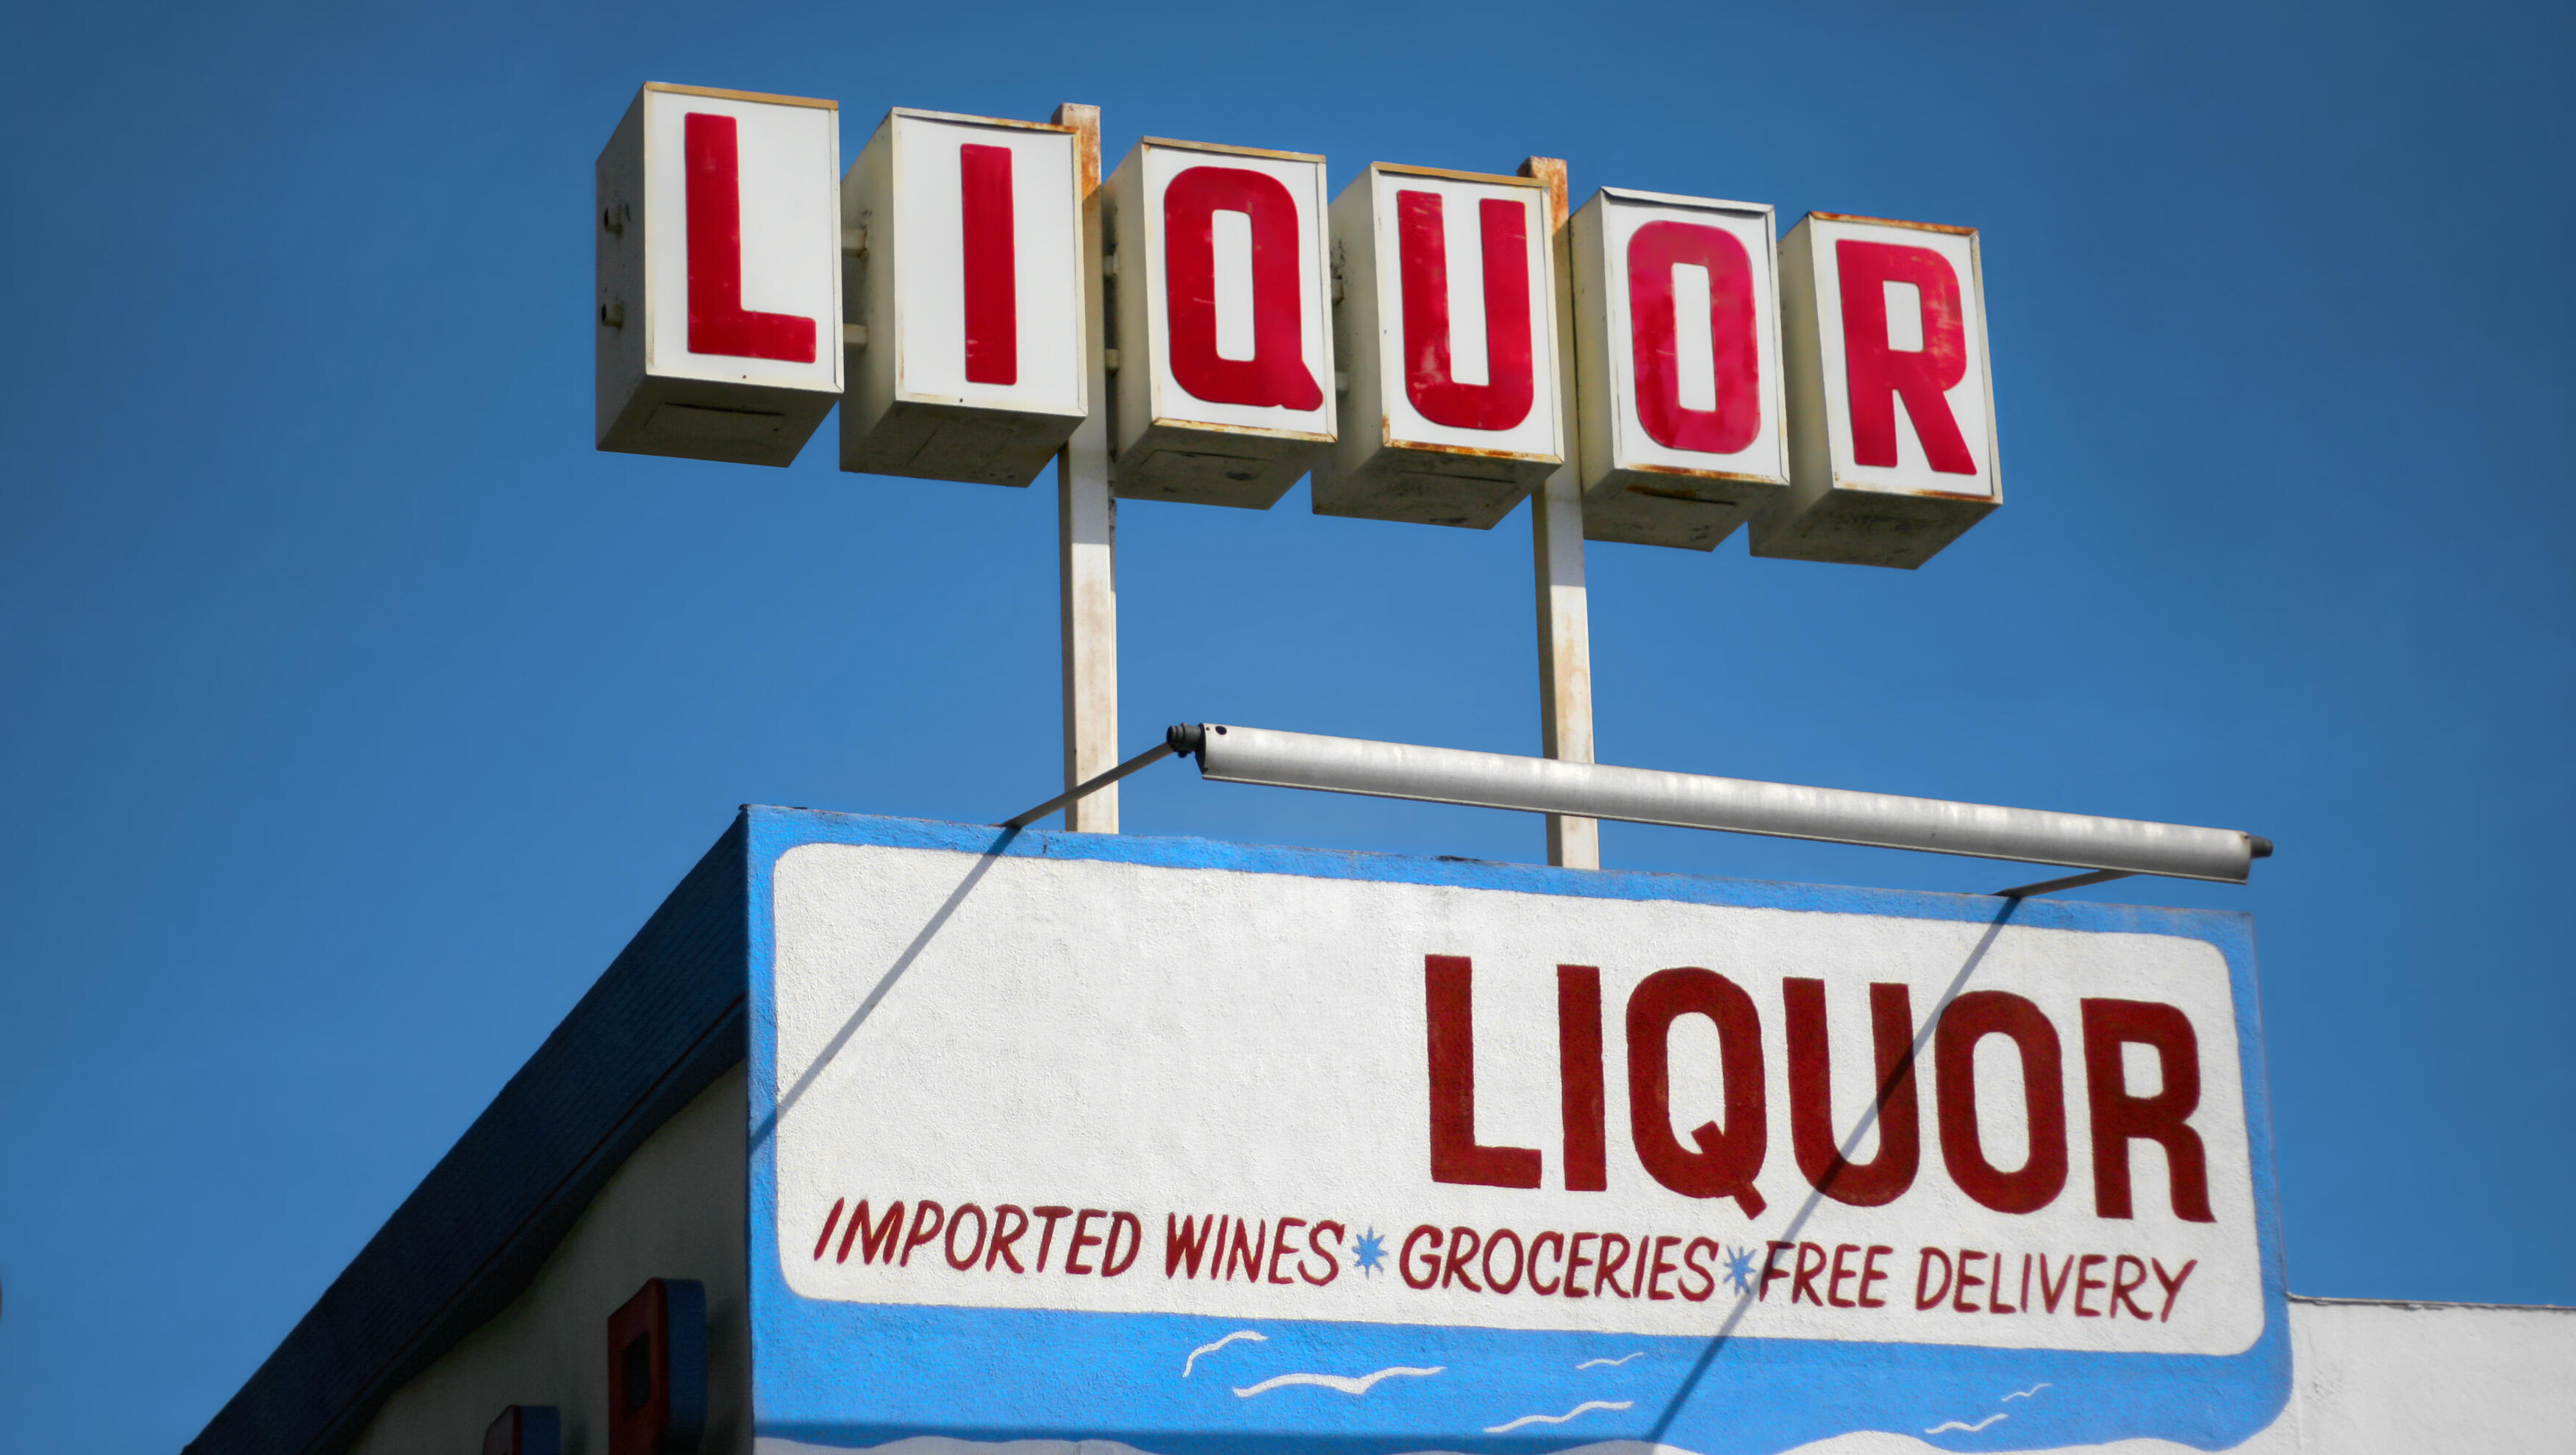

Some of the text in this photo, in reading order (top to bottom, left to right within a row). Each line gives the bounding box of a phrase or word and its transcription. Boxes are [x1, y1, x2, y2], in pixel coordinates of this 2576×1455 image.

[684, 112, 1978, 476] LIQUOR
[1425, 955, 2216, 1223] LIQUOR
[813, 1196, 2199, 1323] IMPORTED WINES GROCERIES FREE DELIVERY
